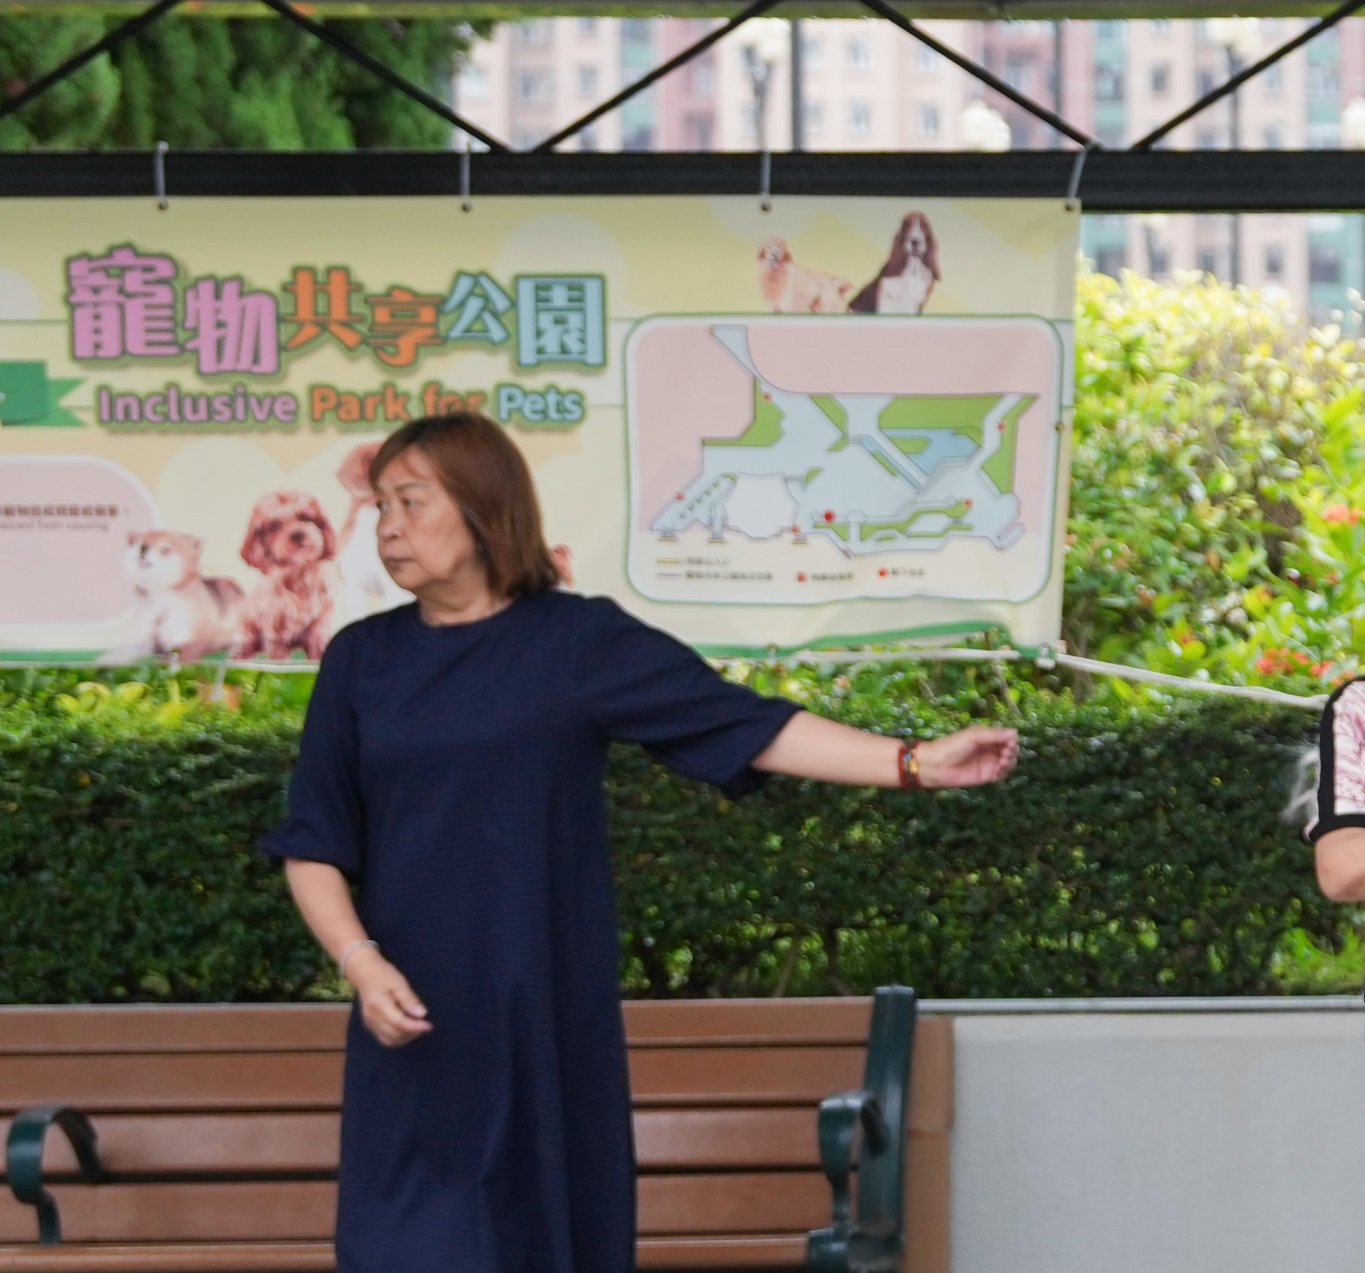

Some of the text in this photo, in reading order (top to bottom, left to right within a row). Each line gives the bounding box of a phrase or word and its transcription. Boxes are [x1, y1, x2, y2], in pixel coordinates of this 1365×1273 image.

[67, 245, 605, 373] 寵物共享公園
[98, 385, 297, 423] Inclusive
[311, 385, 410, 422] Park
[499, 385, 585, 423] Pets
